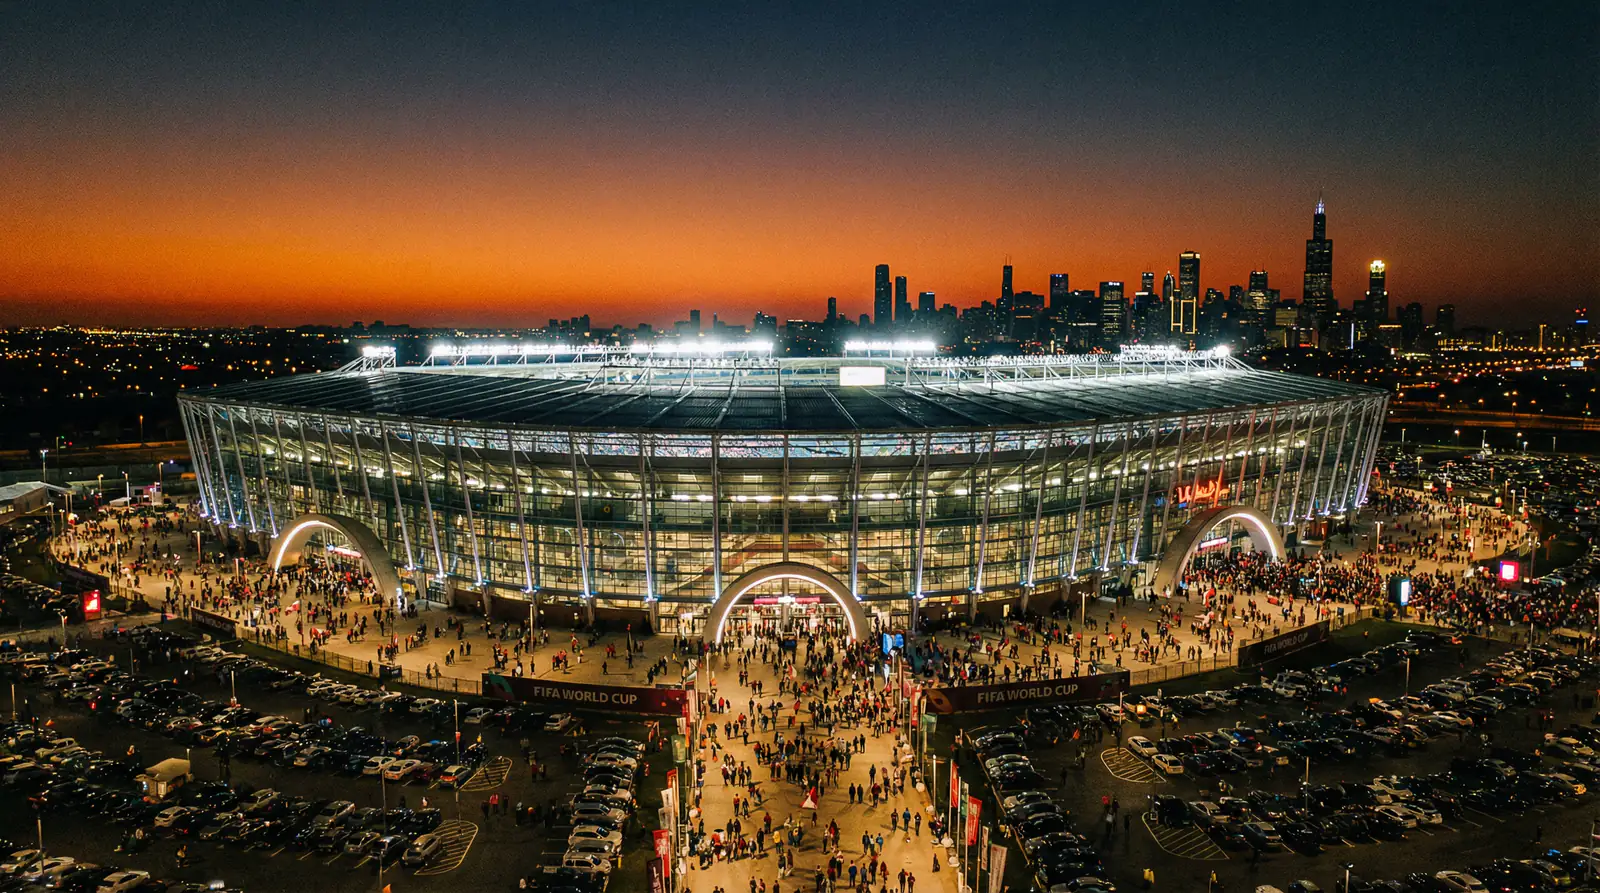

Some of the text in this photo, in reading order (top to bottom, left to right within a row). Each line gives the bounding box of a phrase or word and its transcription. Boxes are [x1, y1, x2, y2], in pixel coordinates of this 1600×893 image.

[534, 686, 637, 704] FIFA WORLD CUP
[977, 684, 1078, 703] FIFA WORLD CUP
